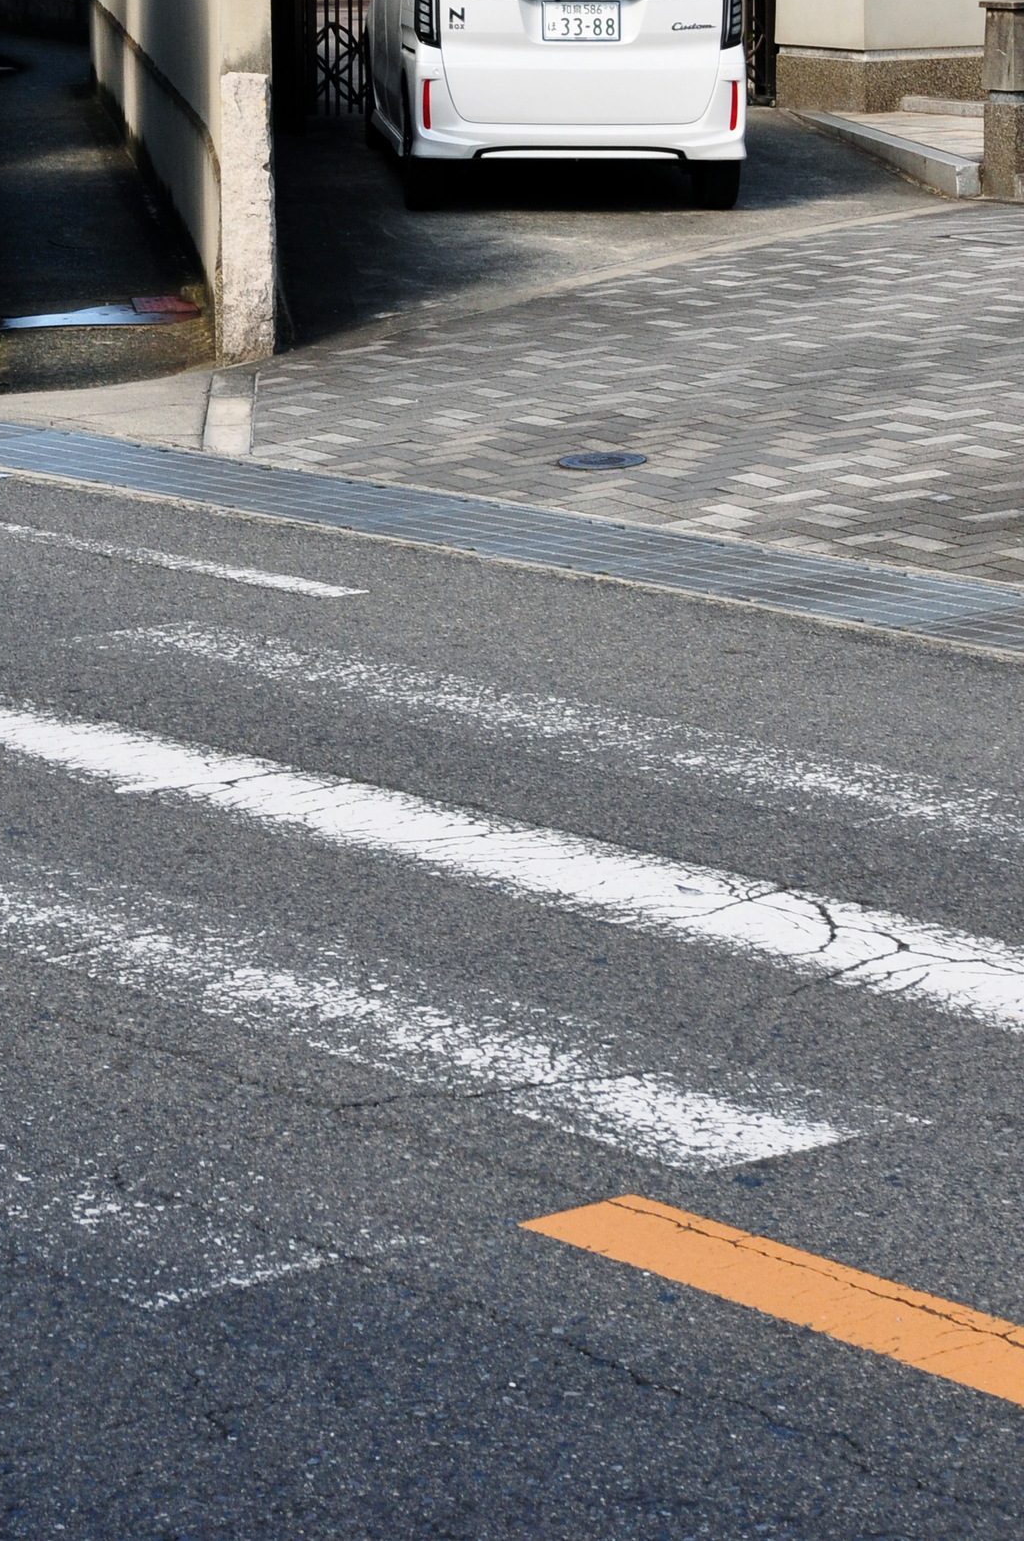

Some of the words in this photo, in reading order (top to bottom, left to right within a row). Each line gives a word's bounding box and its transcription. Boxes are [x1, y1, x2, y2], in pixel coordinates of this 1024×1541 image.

[449, 7, 465, 23] N
[561, 17, 615, 36] 33-88
[671, 22, 717, 31] Custom
